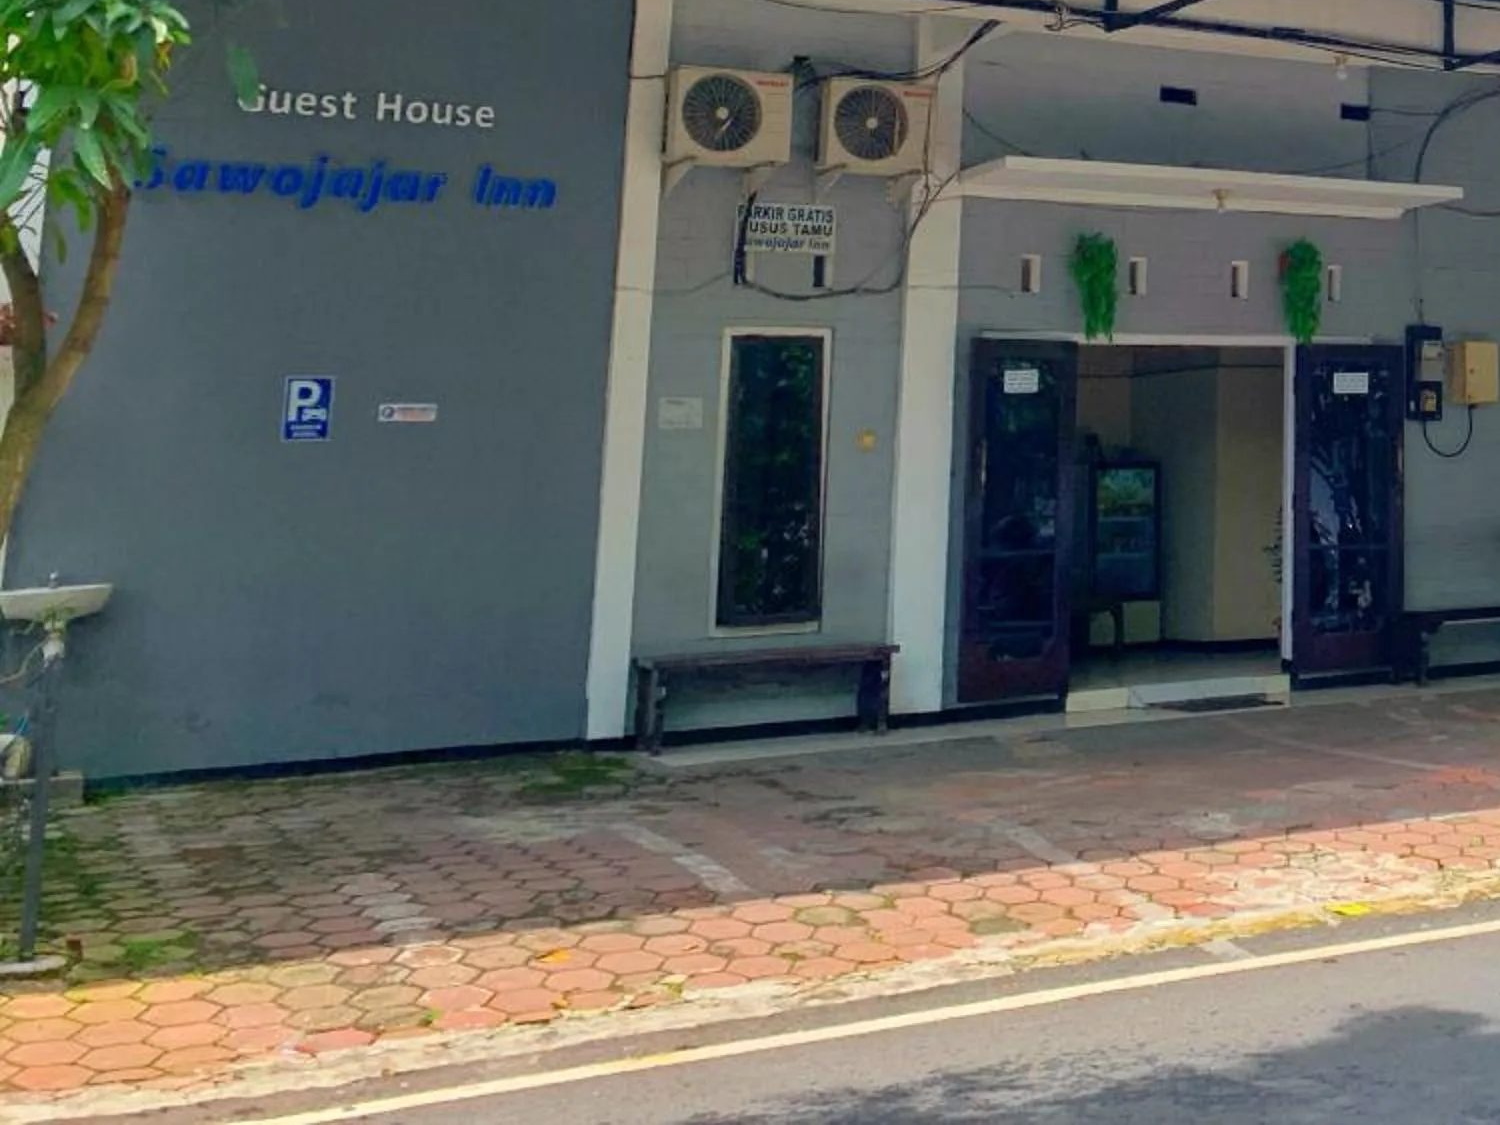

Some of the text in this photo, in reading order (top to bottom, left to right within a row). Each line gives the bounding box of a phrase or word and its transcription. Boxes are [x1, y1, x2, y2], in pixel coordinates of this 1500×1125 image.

[376, 92, 496, 128] House
[475, 164, 558, 208] Inn
[787, 207, 834, 223] GRATIS
[793, 224, 834, 236] TAMU
[288, 380, 321, 421] P
